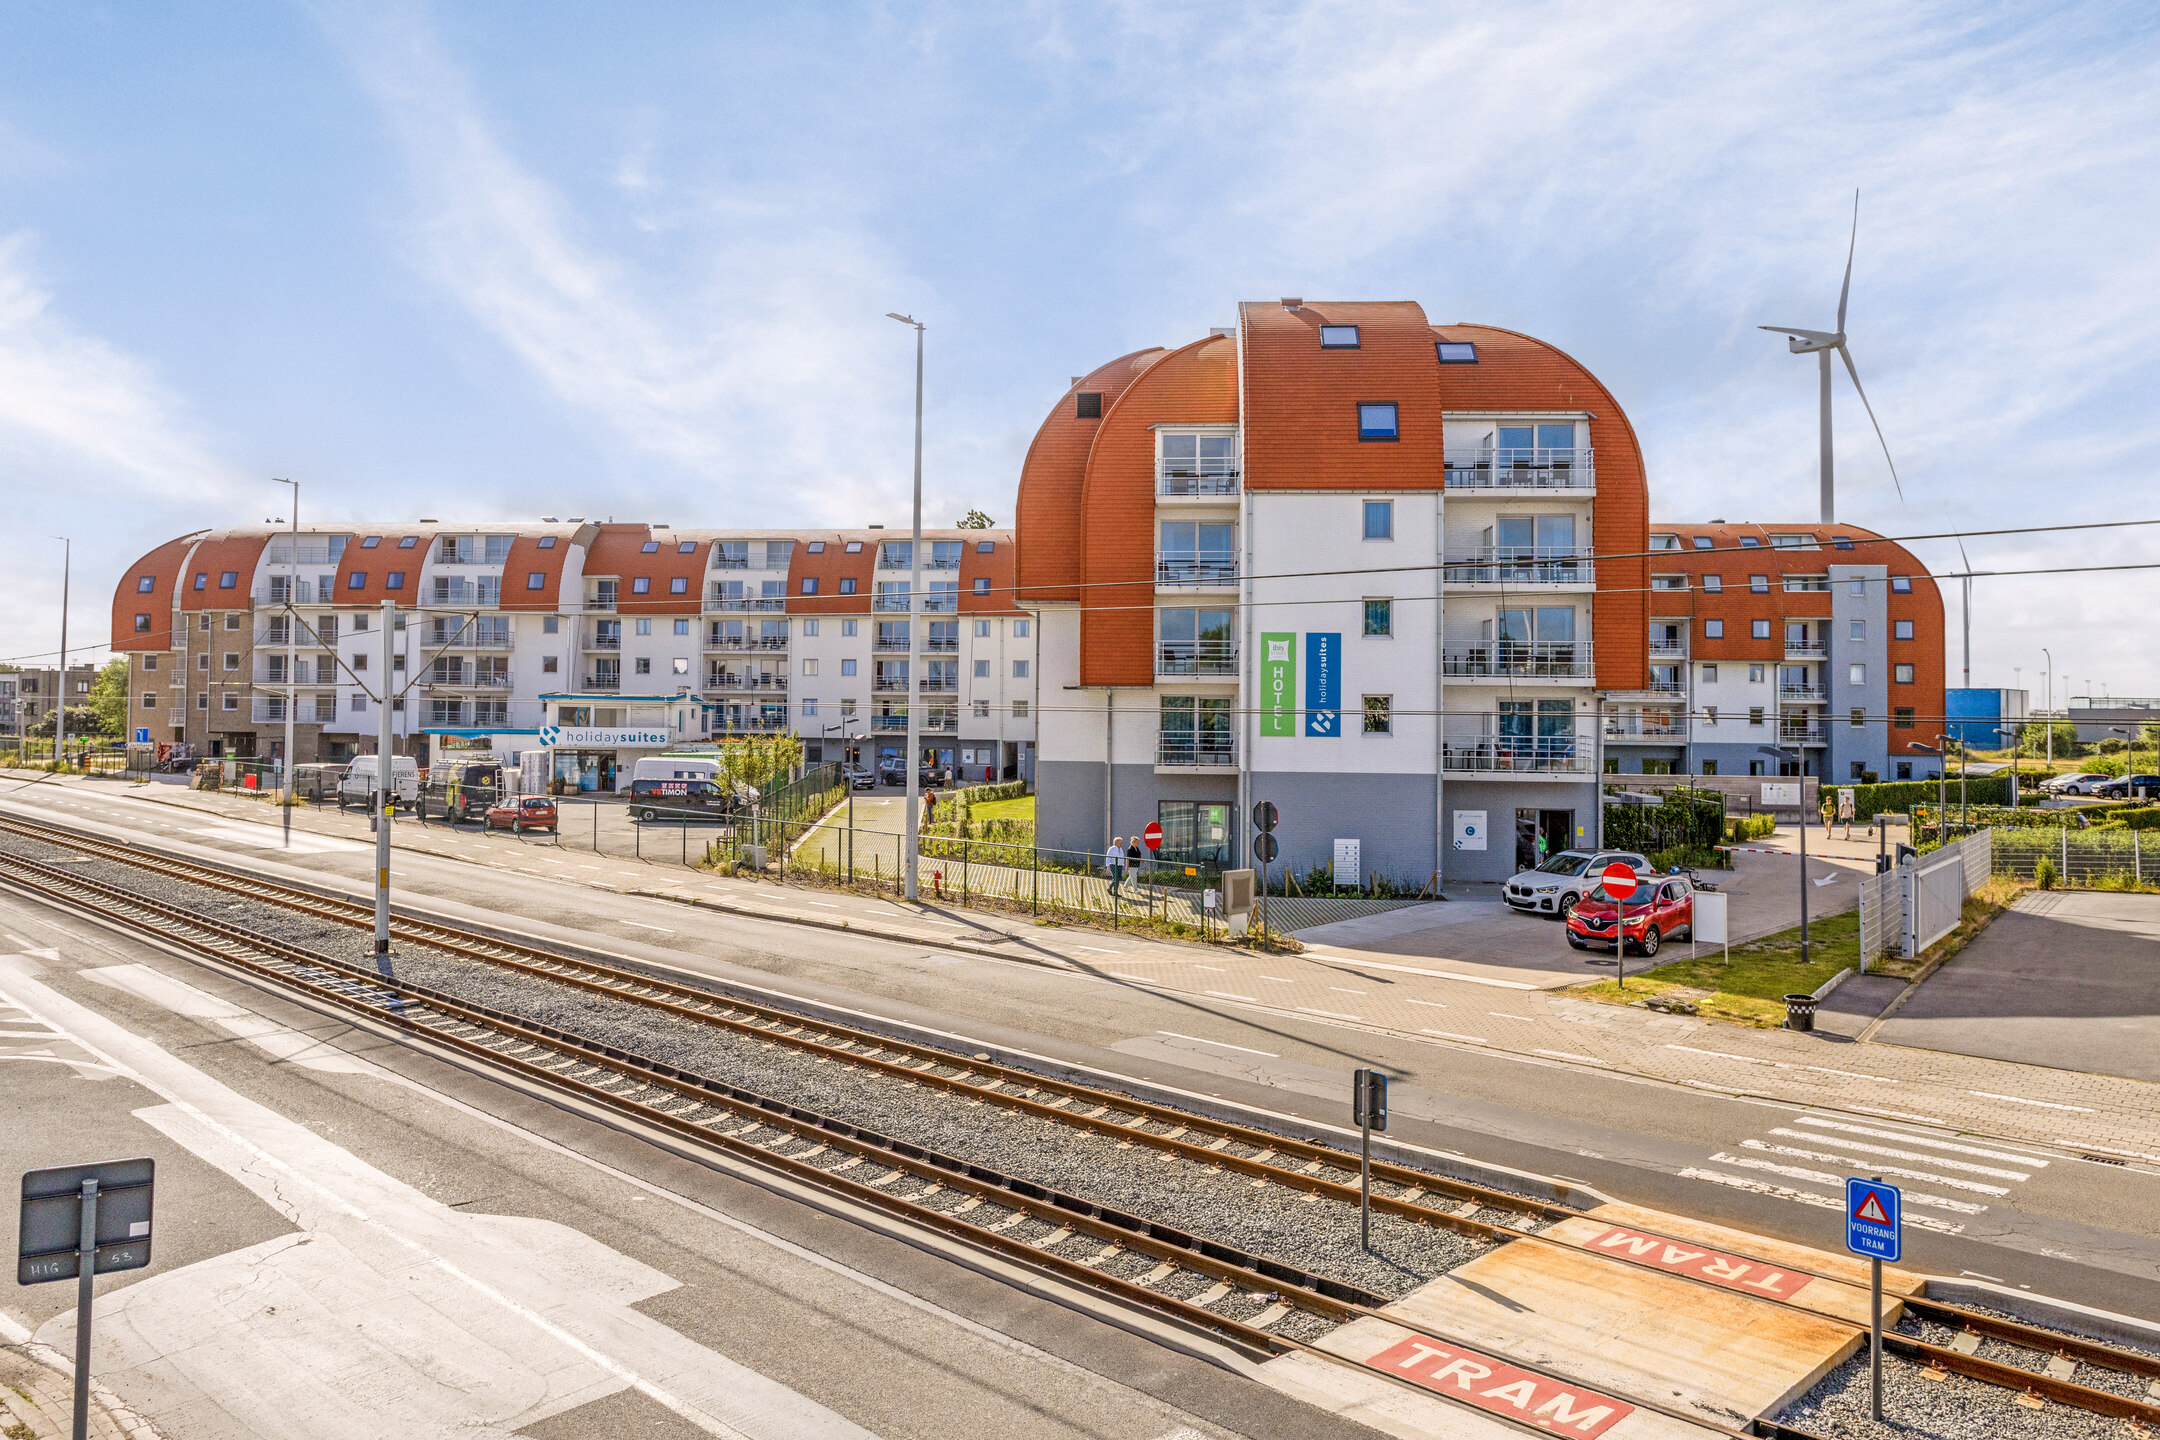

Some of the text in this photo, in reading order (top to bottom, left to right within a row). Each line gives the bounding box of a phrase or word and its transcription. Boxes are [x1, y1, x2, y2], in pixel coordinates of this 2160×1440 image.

[1273, 666, 1284, 730] HOTEL
[1319, 637, 1328, 703] holidaysuites
[566, 731, 666, 744] holidaysuites
[1851, 1222, 1895, 1241] VOORRANG
[1861, 1237, 1885, 1251] TRAM
[1597, 1232, 1785, 1293] TRAM
[1398, 1342, 1616, 1432] TRAM
